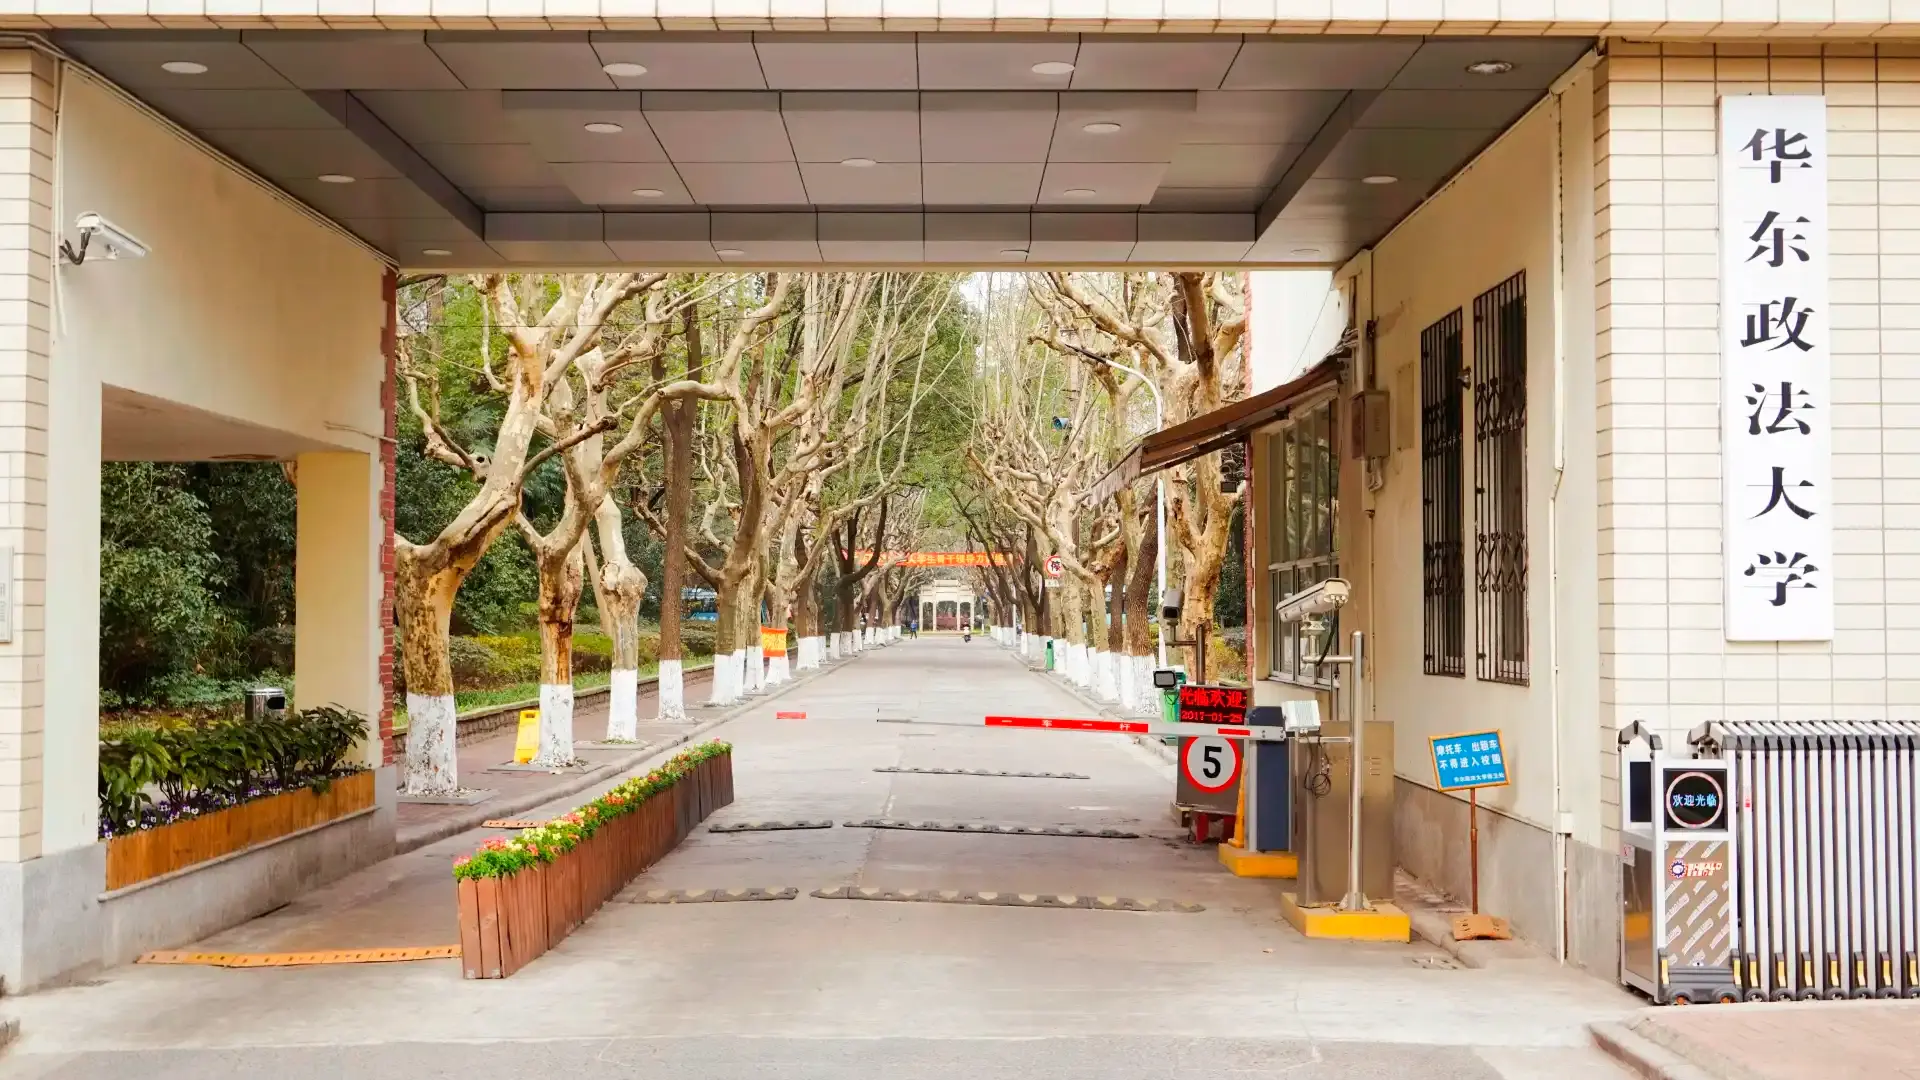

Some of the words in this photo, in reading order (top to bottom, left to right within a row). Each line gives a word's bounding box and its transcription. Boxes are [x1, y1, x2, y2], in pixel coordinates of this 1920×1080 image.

[1738, 127, 1819, 607] 华东政法大学
[1436, 740, 1498, 756] 摩托车、出租车
[1202, 745, 1222, 778] 5
[1439, 754, 1502, 770] 不得进入校园
[1672, 793, 1717, 807] 欢迎光临
